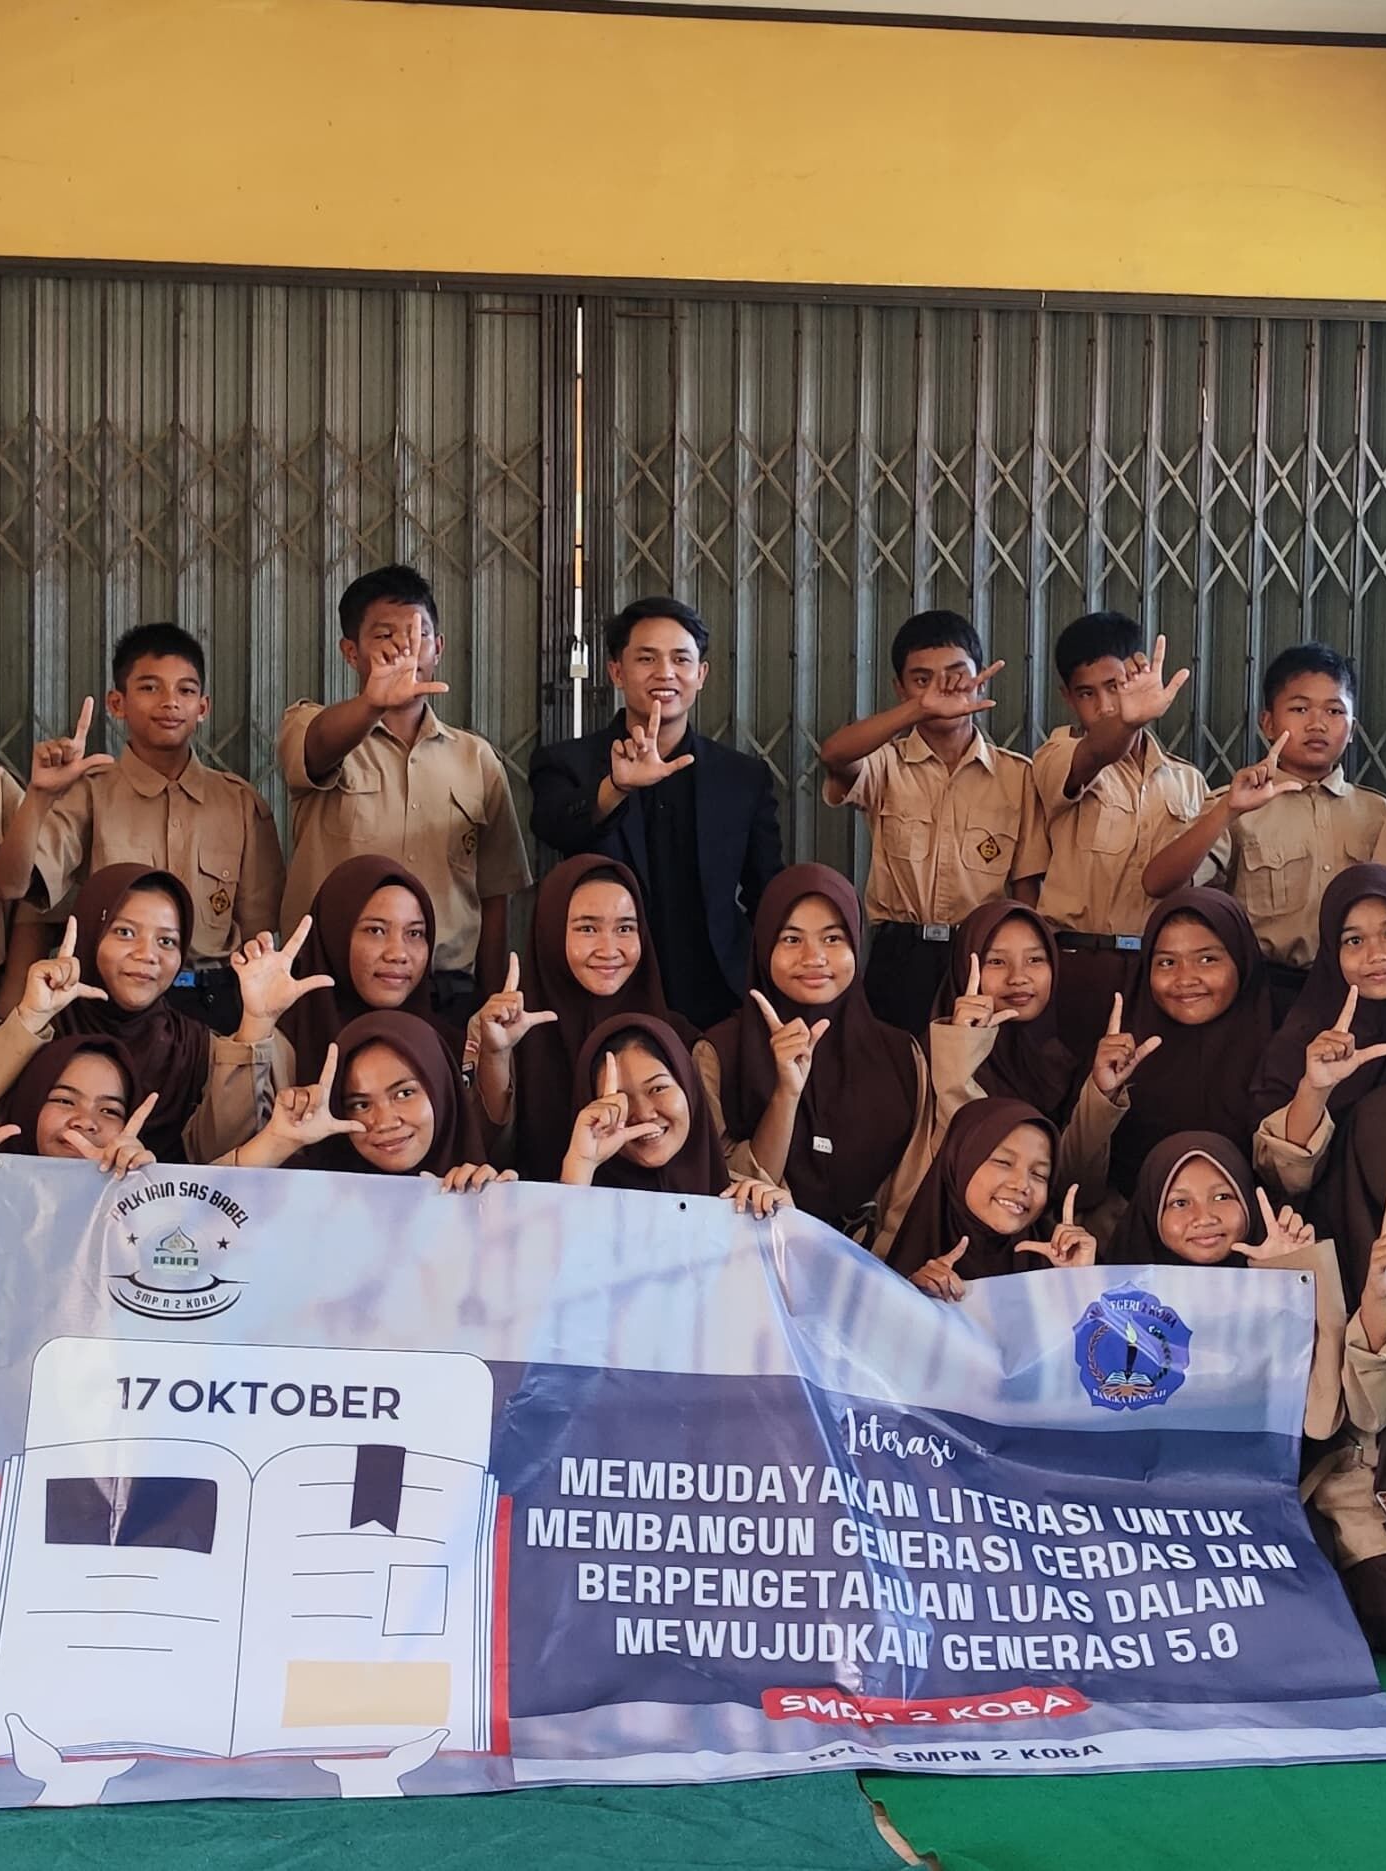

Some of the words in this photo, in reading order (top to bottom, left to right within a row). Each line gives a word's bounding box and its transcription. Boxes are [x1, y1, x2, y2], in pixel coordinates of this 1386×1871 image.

[180, 1181, 209, 1200] SAS
[209, 1191, 249, 1229] BABEL
[134, 1290, 159, 1305] SMP
[175, 1300, 181, 1309] 2
[186, 1294, 217, 1309] KOBA
[117, 1377, 161, 1411] 17
[169, 1379, 401, 1421] OKTOBER
[846, 1407, 956, 1468] Literasi
[560, 1456, 920, 1518] MEMBUDAYAKAN
[928, 1488, 1105, 1536] LITERASI
[1113, 1507, 1253, 1536] UNTUK
[527, 1508, 814, 1556] MEMBANGUN
[833, 1518, 1023, 1573] GENERASI
[1031, 1541, 1196, 1580] CERDAS
[1206, 1543, 1297, 1569] DAN
[578, 1563, 975, 1621] BERPENGETAHUAN
[987, 1584, 1094, 1623] LUAS
[1106, 1575, 1265, 1623] DALAM
[616, 1617, 928, 1669] MEWUJUDKAN
[942, 1633, 1155, 1671] GENERASI
[1166, 1622, 1239, 1663] 5.0
[909, 1711, 937, 1721] 2
[949, 1694, 1072, 1719] KOBA
[893, 1750, 982, 1762] SMPN
[991, 1749, 1013, 1761] 2
[1019, 1744, 1103, 1760] KOBA
